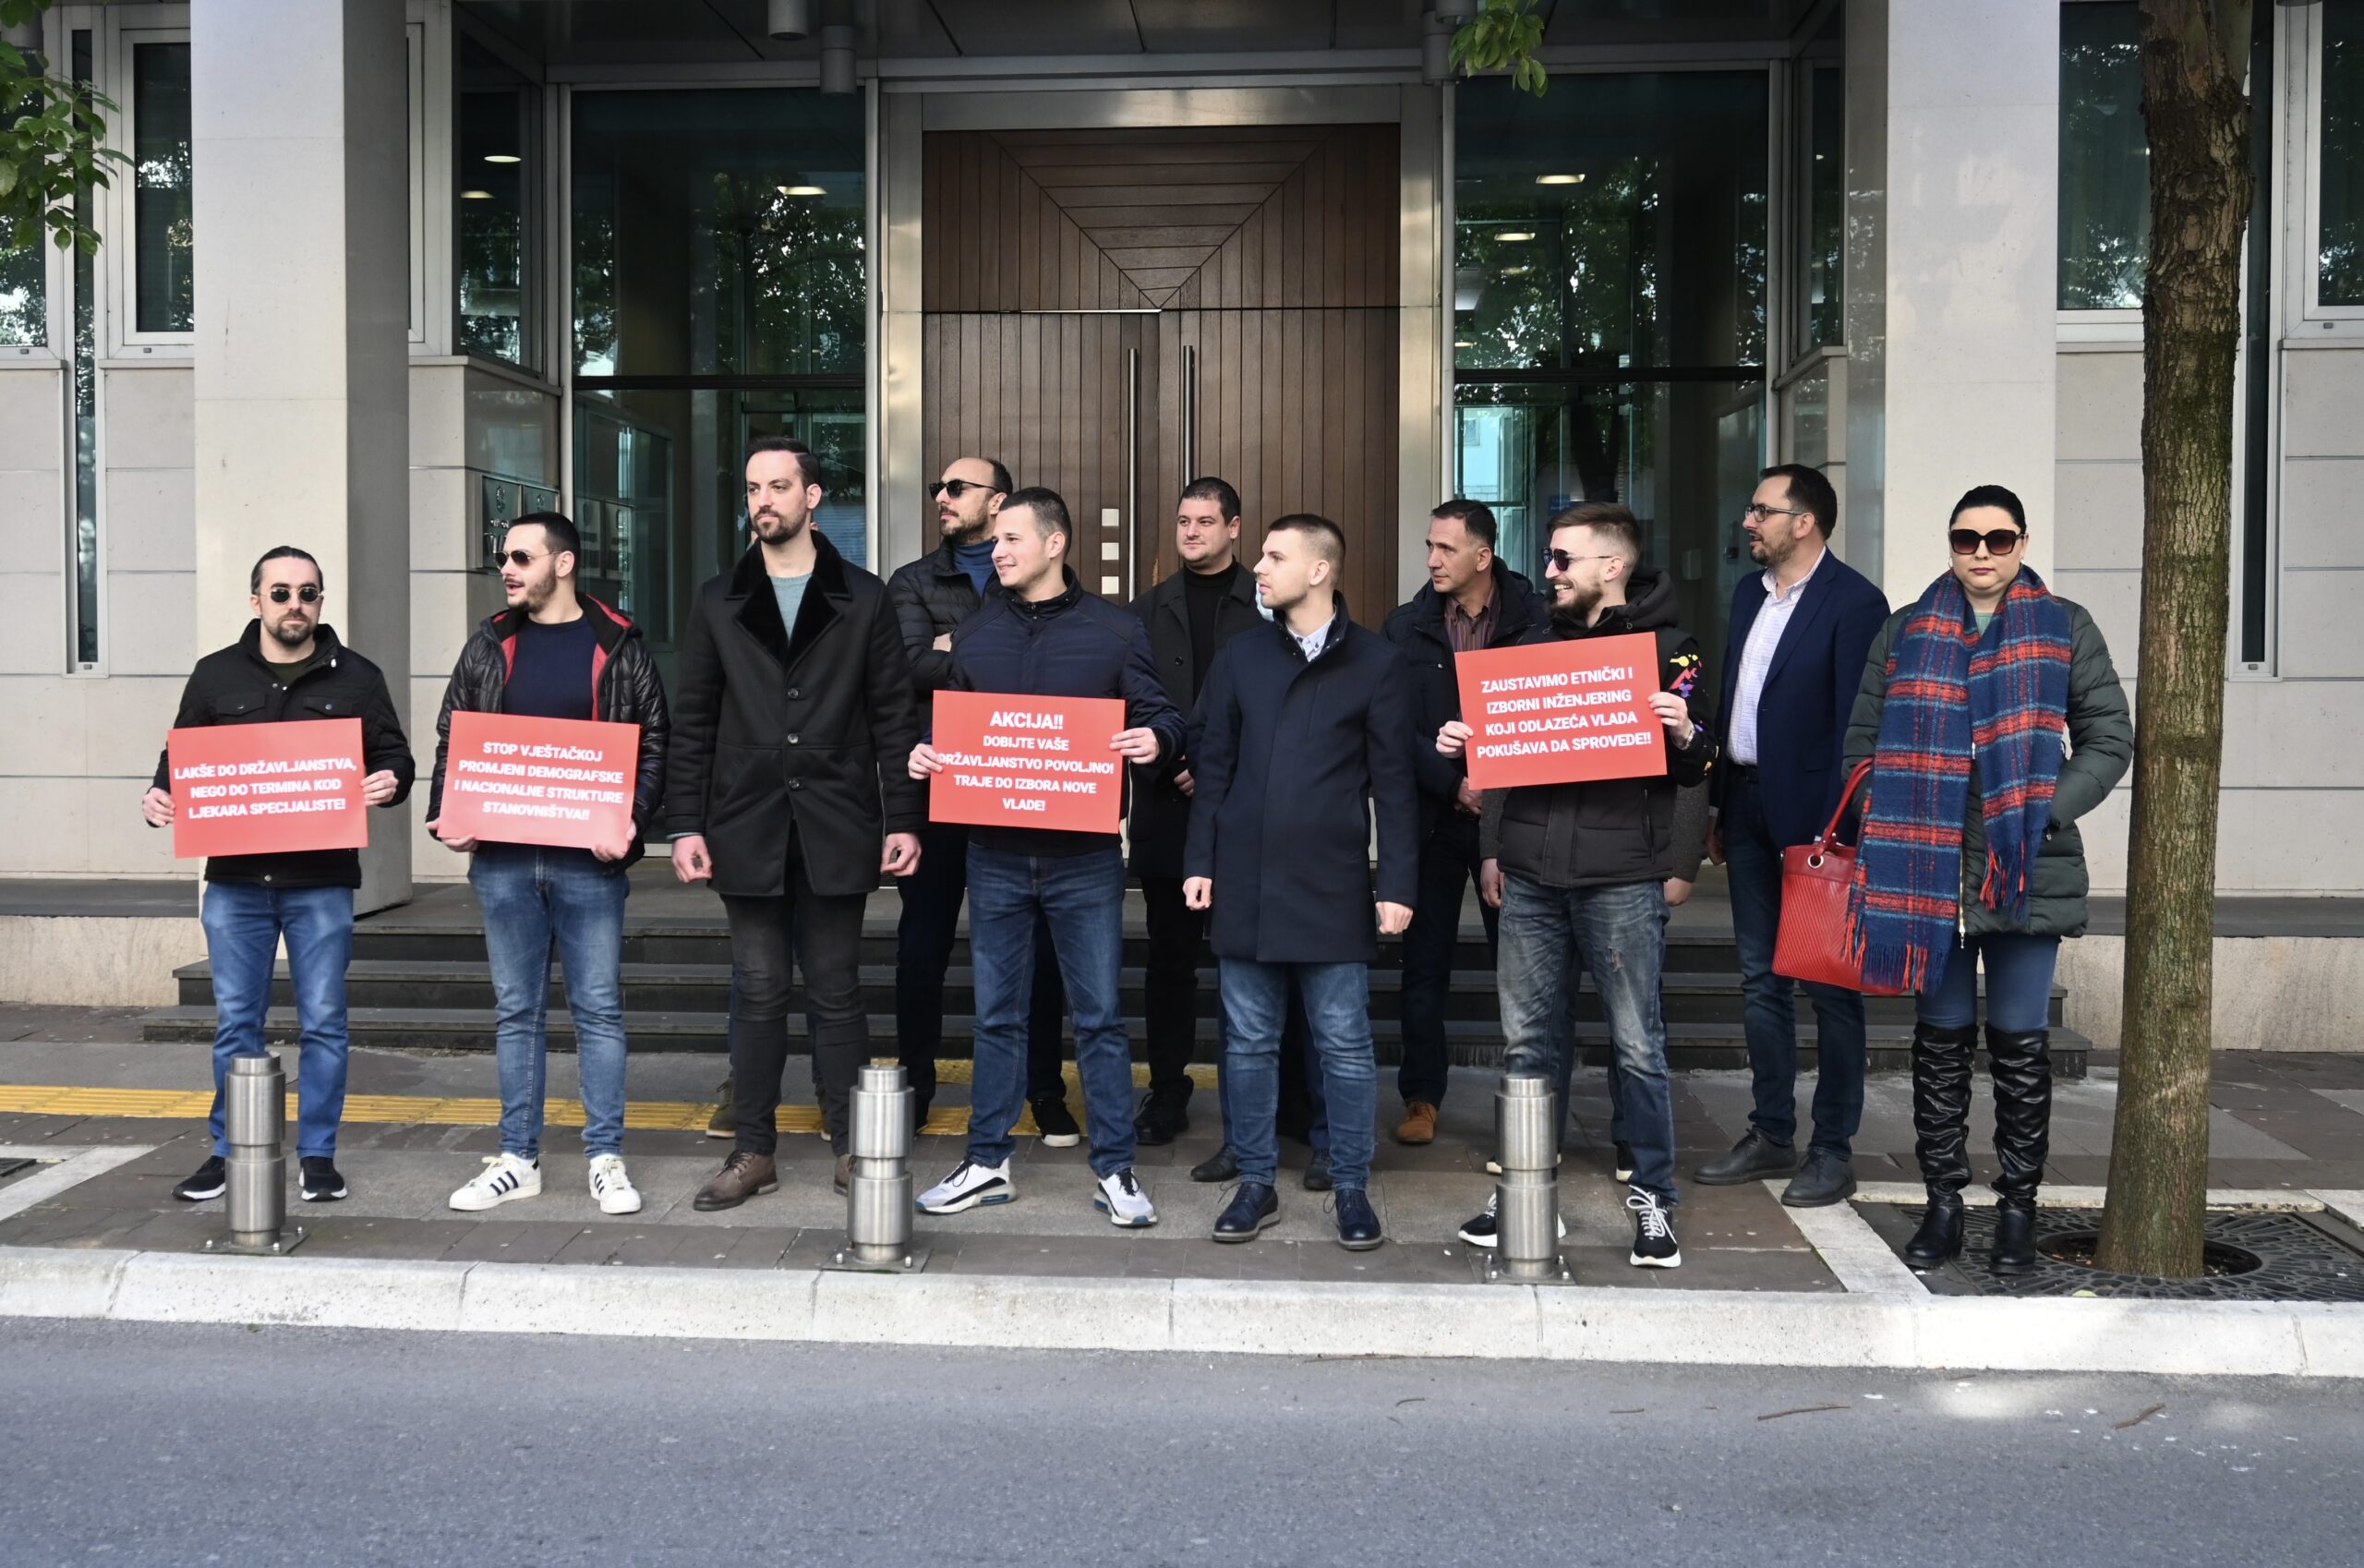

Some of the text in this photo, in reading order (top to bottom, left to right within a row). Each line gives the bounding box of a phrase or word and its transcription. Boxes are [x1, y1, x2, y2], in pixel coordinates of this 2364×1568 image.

[1480, 665, 1633, 694] ZAUSTAVIMO ETNIČKI I
[1486, 689, 1633, 715] IZBORNI INŽENJERING
[989, 710, 1064, 730] AKCIJA!!
[1485, 710, 1638, 736] KOJI ODLAZEĆA VLADA
[482, 742, 603, 763] STOP VJEŠTAČKOJ
[983, 735, 1070, 751] DOBIJTE VAŠE
[1477, 731, 1652, 759] POKUŠAVA DA SPROVEDE!!
[175, 757, 357, 780] LAKŠE DO DRŽAVLJANSTVA,
[458, 759, 624, 784] PROMJENI DEMOGRAFSKE
[1044, 759, 1115, 774] POVOLJNO!
[190, 778, 342, 799] NEGO DO TERMINA KOD
[455, 779, 623, 803] I NACIONALNE STRUKTURE
[953, 774, 1097, 794] TRAJE DO IZBORA NOVE
[188, 798, 346, 819] LJEKARA SPECIJALISTE!
[482, 801, 591, 820] STANOVNIŠTVA!!
[1002, 797, 1046, 811] VLADE!
